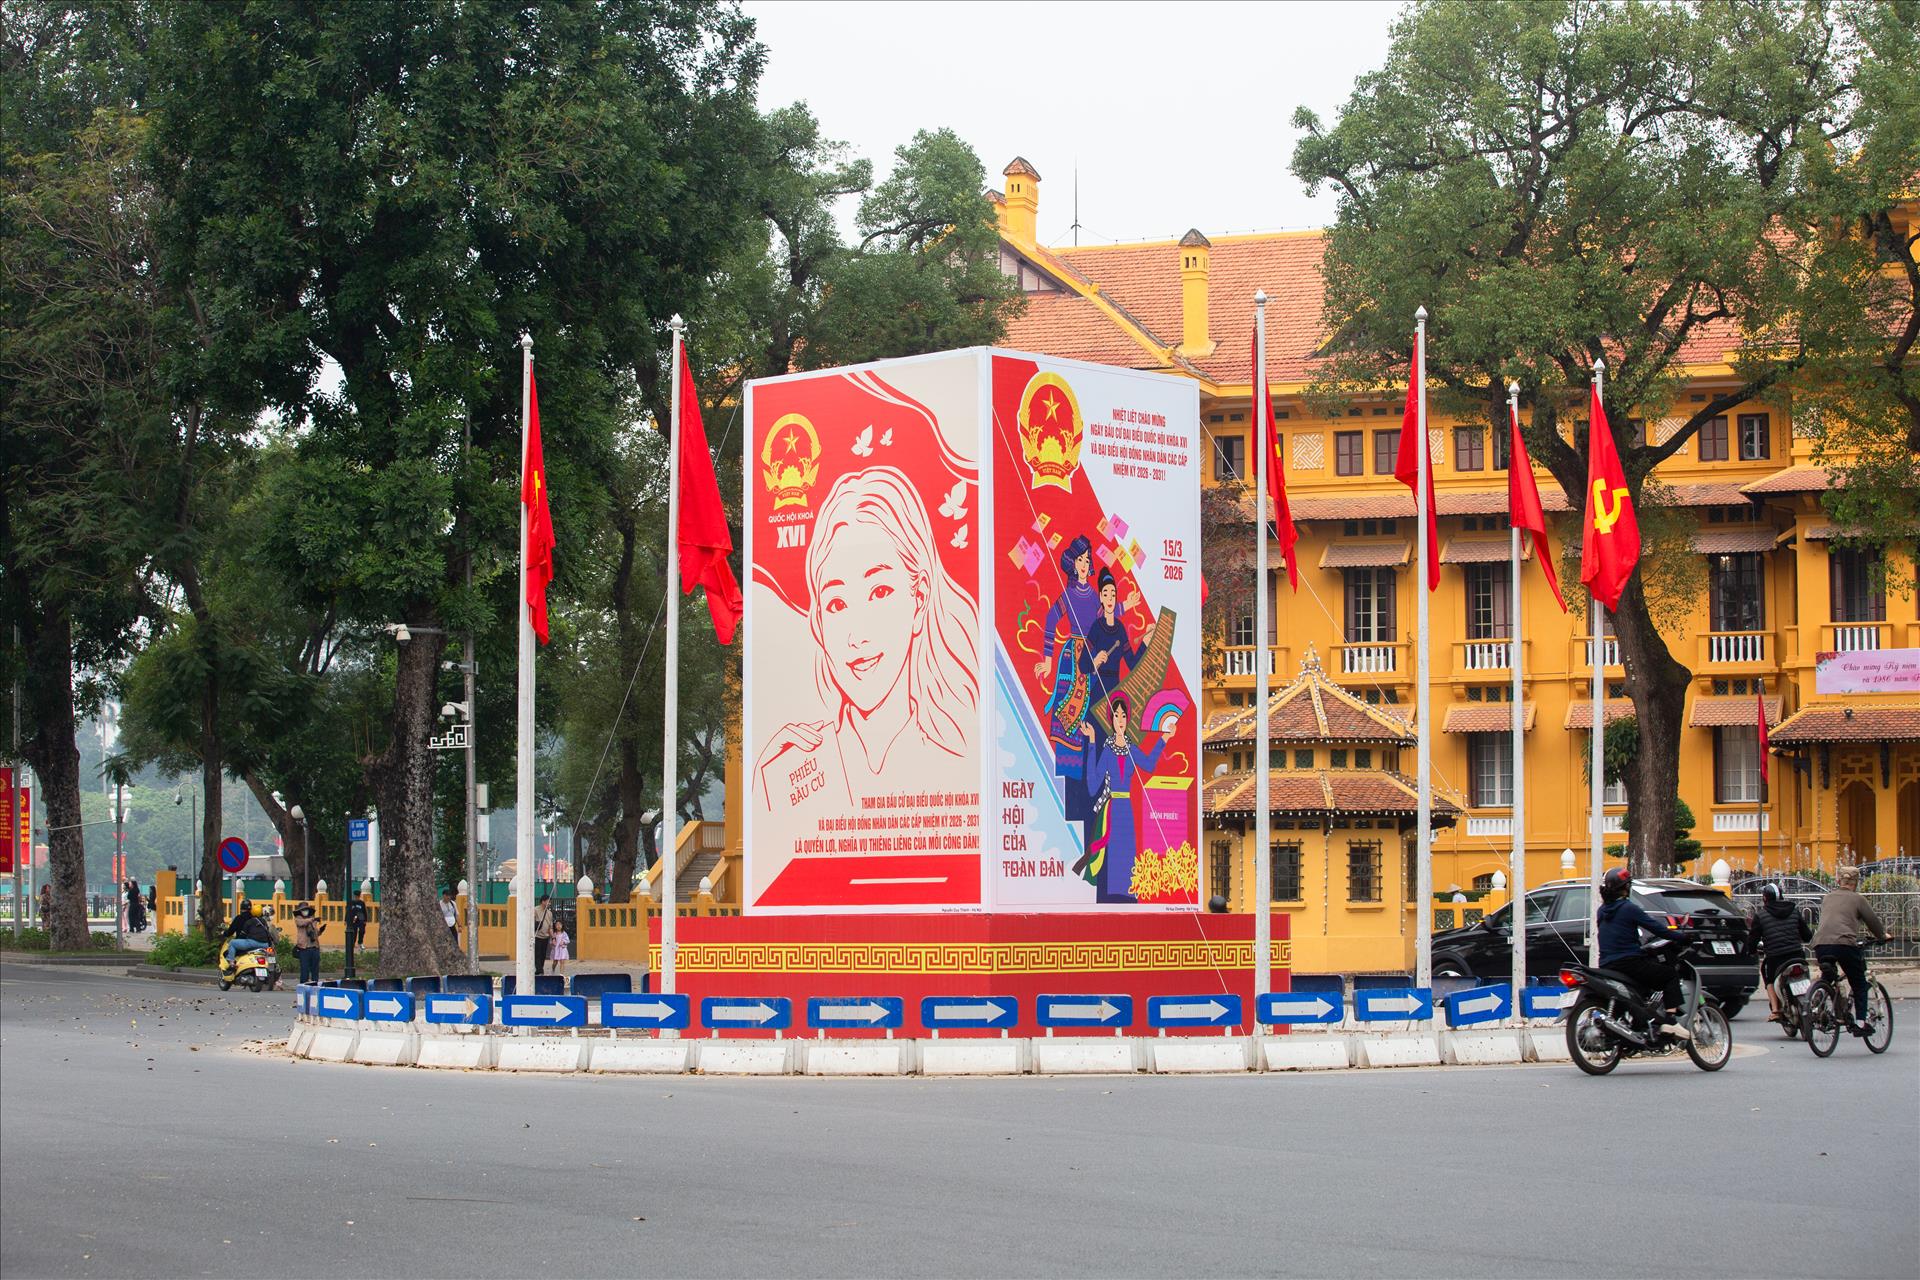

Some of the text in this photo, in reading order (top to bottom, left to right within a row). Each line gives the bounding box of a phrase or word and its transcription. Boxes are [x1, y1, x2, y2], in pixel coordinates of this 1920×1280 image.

[1112, 408, 1166, 427] NHIỆT LIỆT CHÀO MỪNG
[1090, 422, 1104, 436] NGÀY
[1123, 427, 1131, 442] ĐẠI
[1132, 426, 1142, 442] BIỂU
[1144, 429, 1156, 444] QUỐC
[1091, 440, 1188, 466] VÀ ĐẠI BIỂU HỘI ĐỒNG NHÂN DÂN CÁC CẤP
[1113, 462, 1128, 478] NHIỆM
[1137, 467, 1148, 479] 2026
[1152, 468, 1166, 481] 2031!
[768, 512, 785, 523] QUỐC
[786, 510, 797, 523] HỘI
[777, 524, 806, 548] XVI
[1164, 539, 1182, 557] 15/3
[1164, 565, 1183, 580] 2026
[1840, 662, 1860, 671] Chào
[789, 757, 817, 786] PHIẾU
[790, 770, 825, 806] BẦU CỬ
[1002, 778, 1035, 799] NGÀY
[862, 796, 875, 809] THAM
[877, 797, 885, 808] GIA
[907, 795, 915, 810] ĐẠI
[916, 790, 928, 807] BIỂU
[930, 790, 943, 808] QUỐC
[945, 792, 953, 808] HỘI
[970, 793, 979, 805] XVI
[826, 818, 834, 833] ĐẠI
[836, 814, 846, 830] BIỂU
[848, 816, 856, 832] HỘI
[858, 814, 871, 830] ĐỒNG
[872, 815, 886, 829] NHÂN
[888, 814, 898, 829] DÂN
[900, 814, 910, 828] CÁC
[911, 812, 921, 828] CẤP
[923, 813, 940, 830] NHIỆM
[949, 815, 962, 827] 2026
[967, 814, 979, 827] 2031
[1002, 805, 1024, 828] HỘI
[795, 837, 802, 853] LÀ
[804, 835, 824, 854] QUYỀN
[826, 838, 837, 855] LỢI,
[839, 836, 857, 852] NGHĨA
[859, 838, 867, 854] VỤ
[869, 835, 891, 851] THIÊNG
[893, 834, 912, 850] LIÊNG
[914, 831, 926, 850] CỦA
[943, 833, 961, 849] CÔNG
[963, 833, 980, 848] DÂN!
[1003, 830, 1027, 851] CỦA
[1003, 857, 1064, 877] TOÀN DÂN
